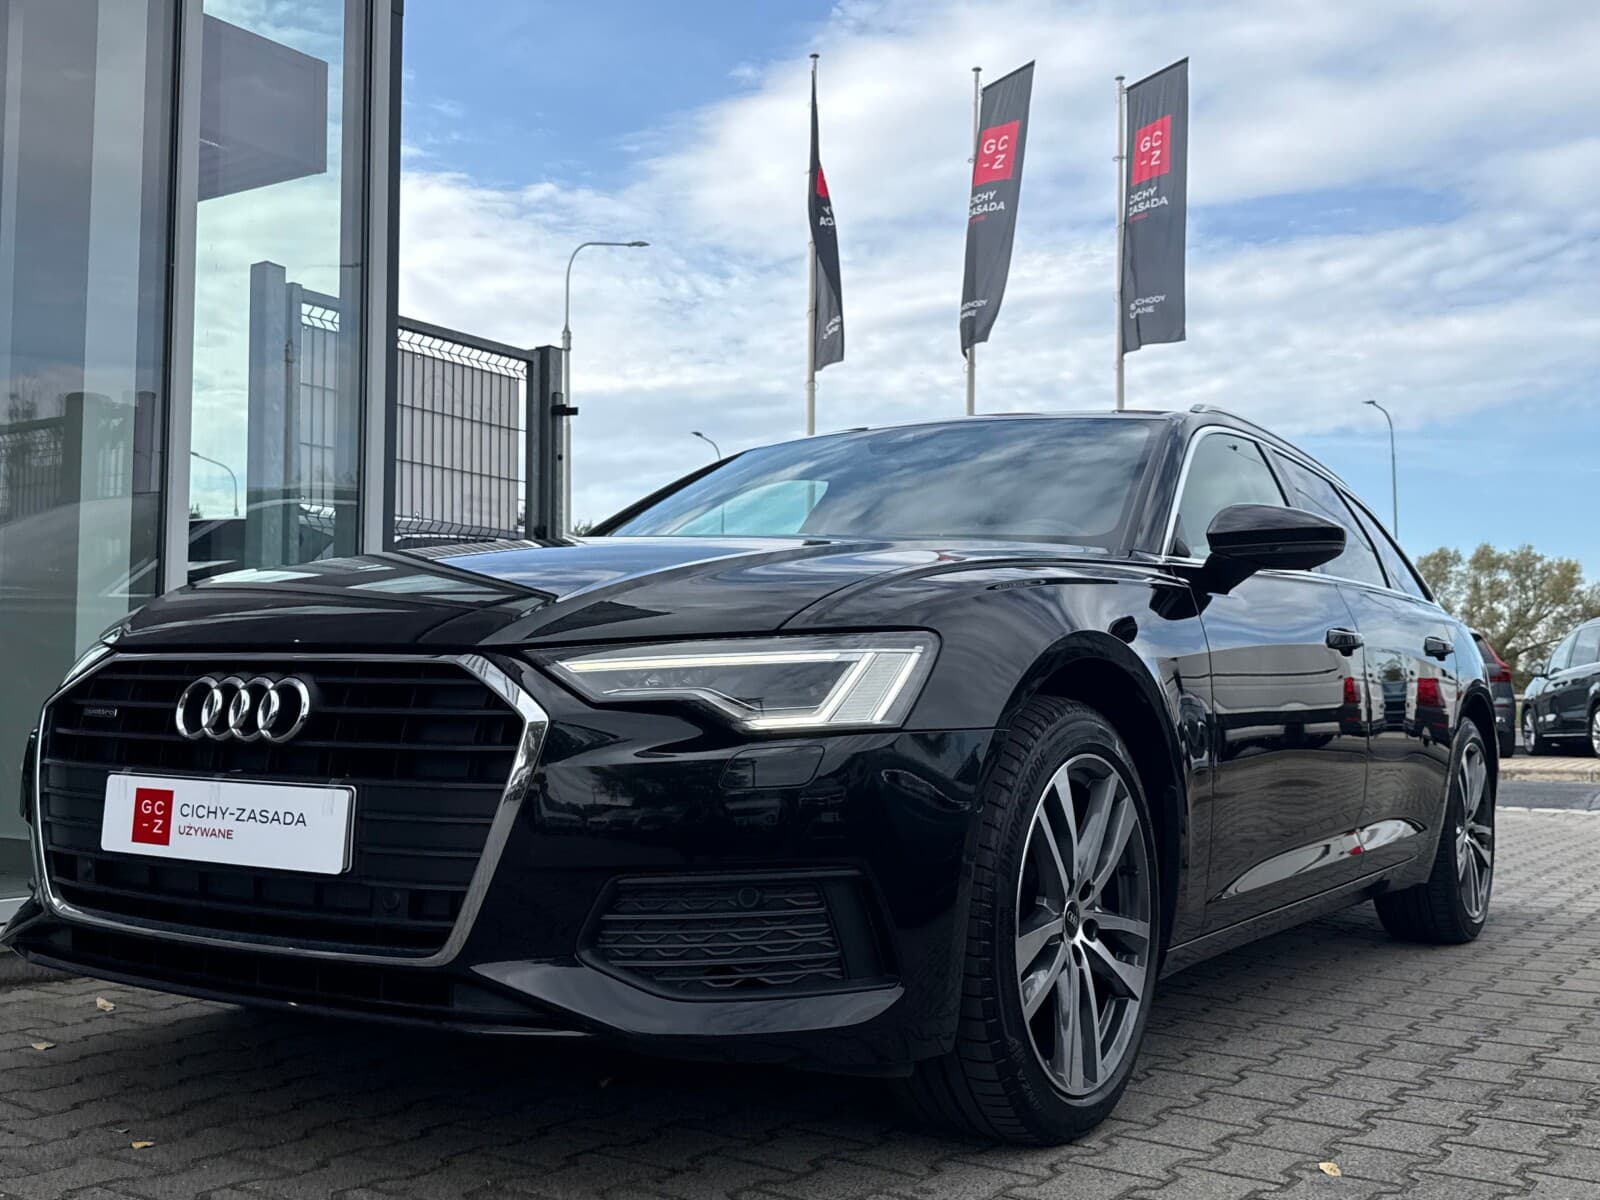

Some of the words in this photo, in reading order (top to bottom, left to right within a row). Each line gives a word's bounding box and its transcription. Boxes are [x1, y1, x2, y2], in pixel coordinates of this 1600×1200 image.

[983, 135, 1009, 155] GC
[1140, 130, 1162, 153] GC
[141, 800, 165, 816] GC
[179, 803, 308, 828] CICHY-ZASADA
